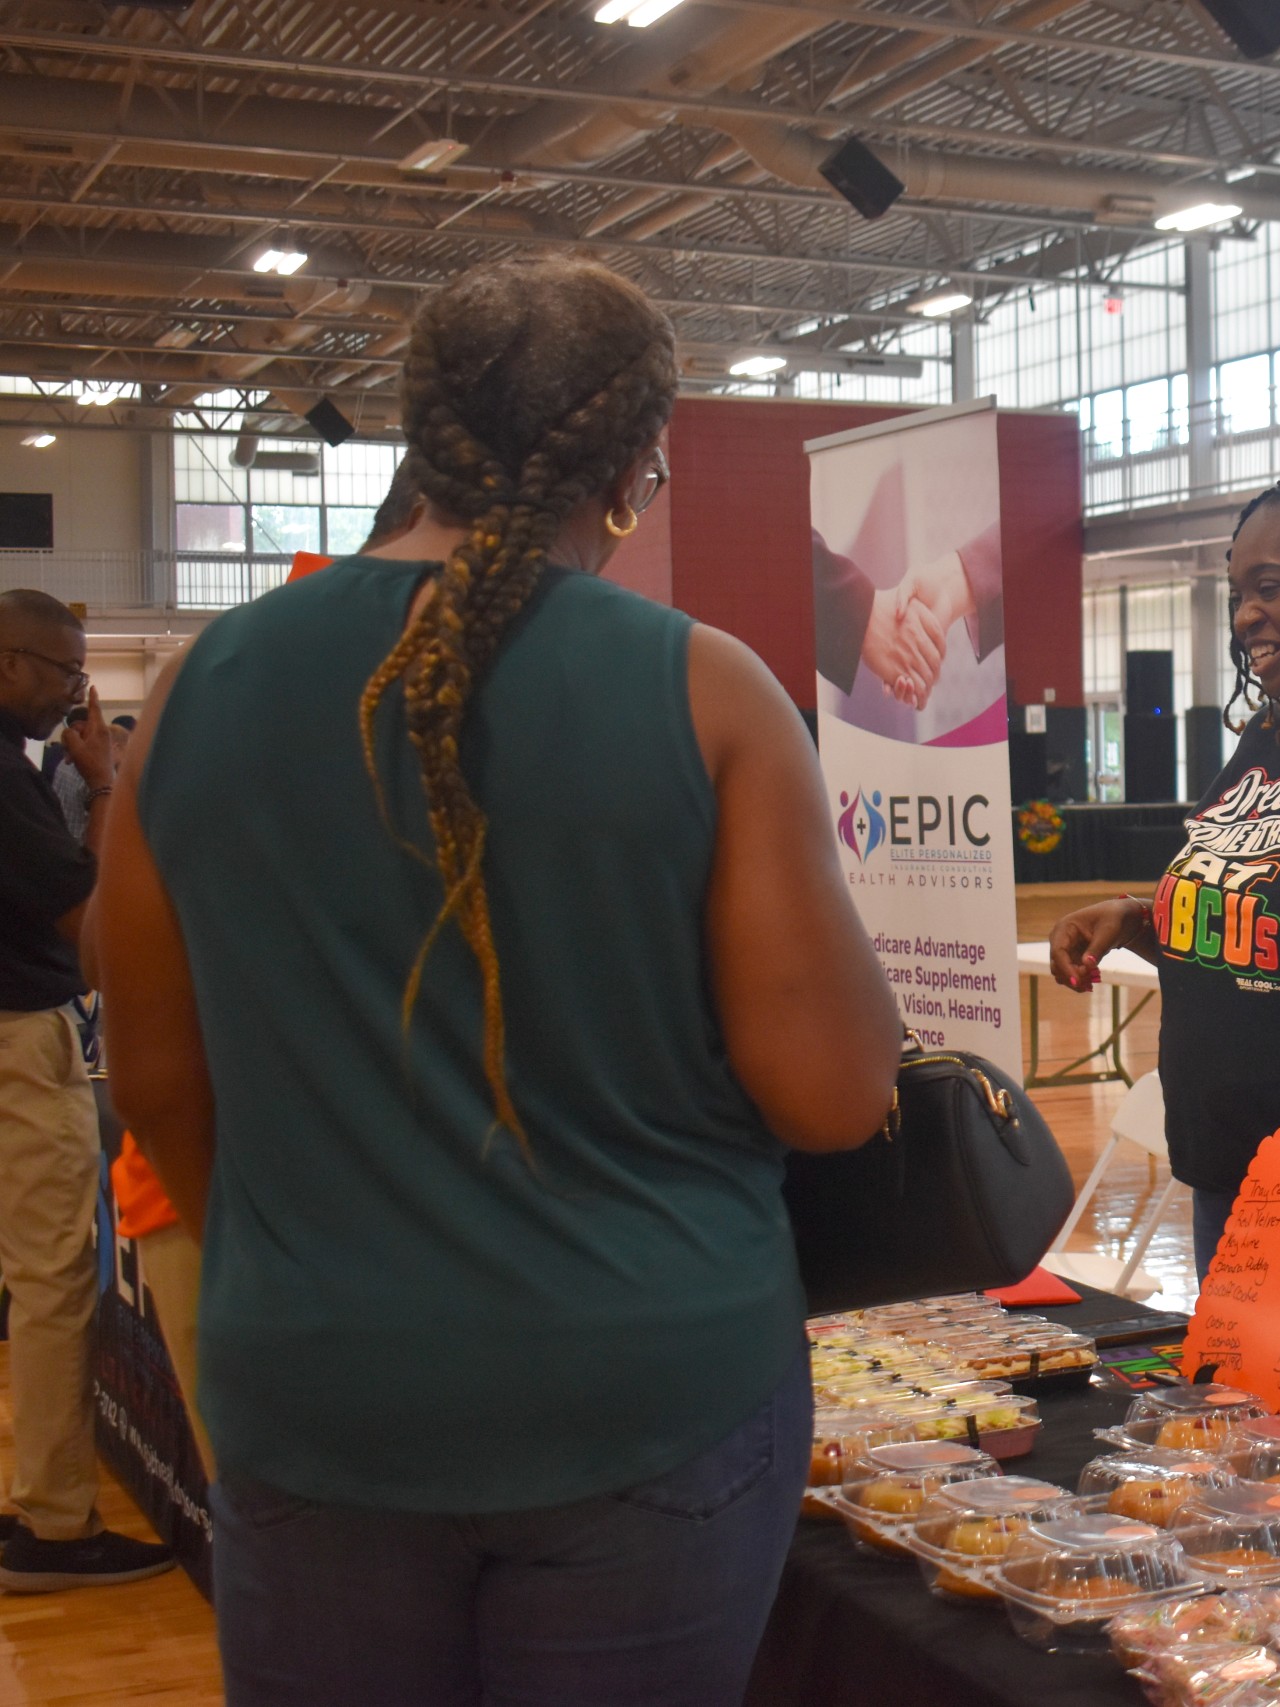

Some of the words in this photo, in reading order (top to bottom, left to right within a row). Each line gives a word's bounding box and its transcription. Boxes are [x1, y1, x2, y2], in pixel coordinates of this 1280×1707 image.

[889, 794, 992, 847] EPIC
[890, 848, 915, 858] ELITE
[919, 849, 992, 860] PERSONALIZED
[849, 872, 896, 885] EALTH
[907, 875, 993, 889] ADVISORS
[1180, 851, 1272, 891] AT
[873, 932, 912, 955] dicare
[914, 936, 986, 965] Advantage
[915, 965, 997, 992] Supplement
[903, 992, 946, 1019] Vision,
[948, 998, 1002, 1029] Hearing
